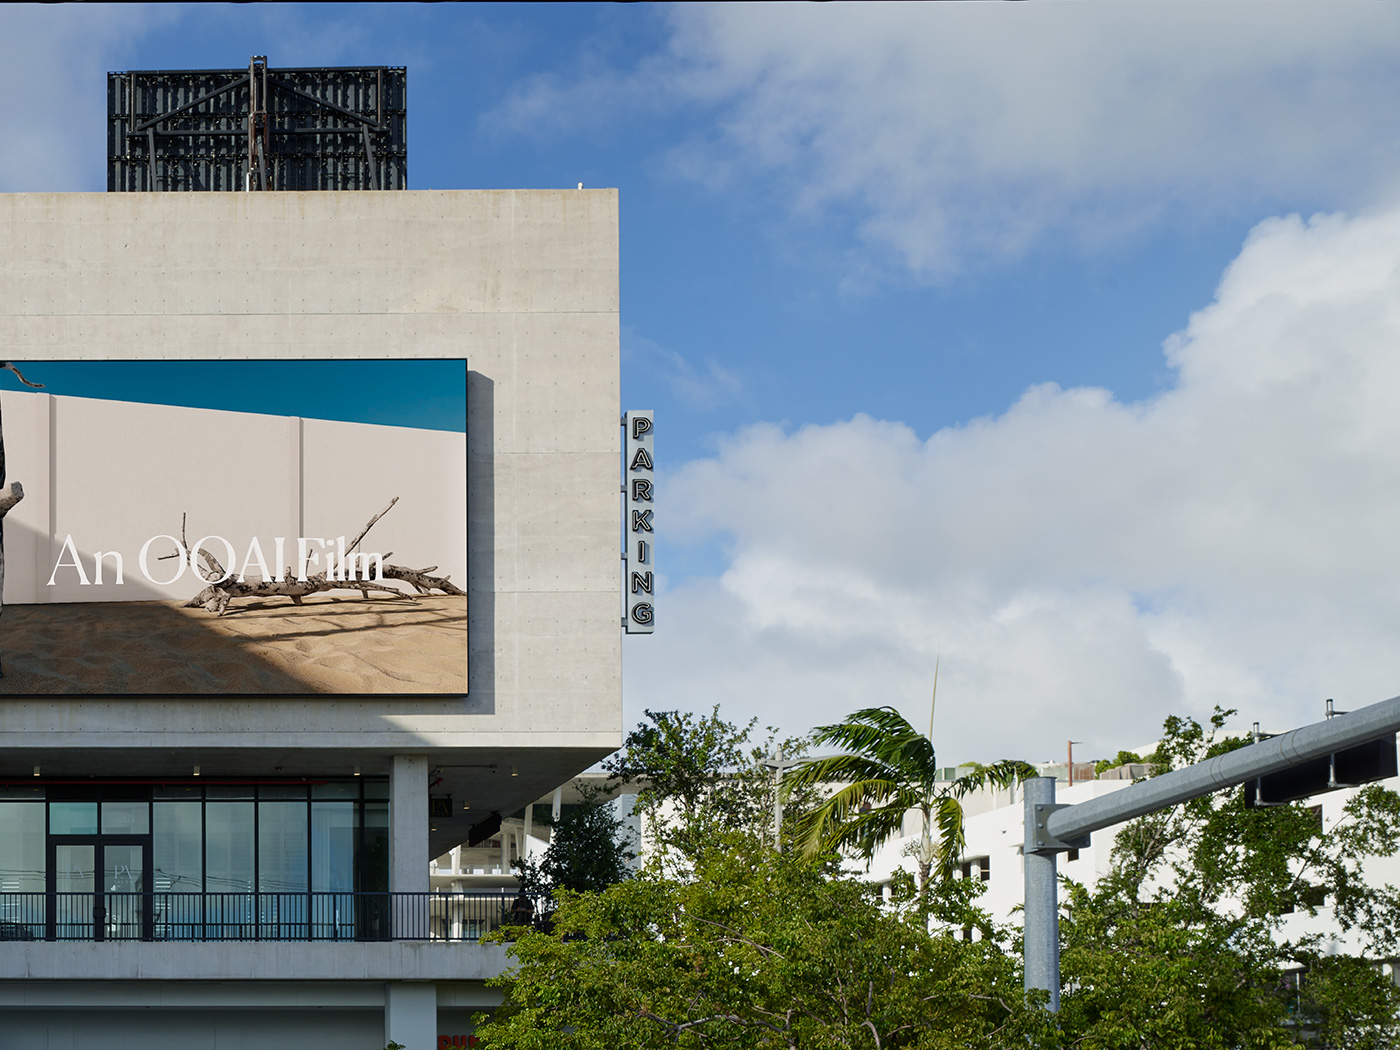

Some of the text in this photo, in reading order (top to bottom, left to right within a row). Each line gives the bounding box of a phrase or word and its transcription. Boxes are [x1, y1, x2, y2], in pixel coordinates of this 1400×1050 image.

[46, 534, 125, 586] An
[297, 535, 384, 582] Film
[630, 416, 652, 625] PARKING
